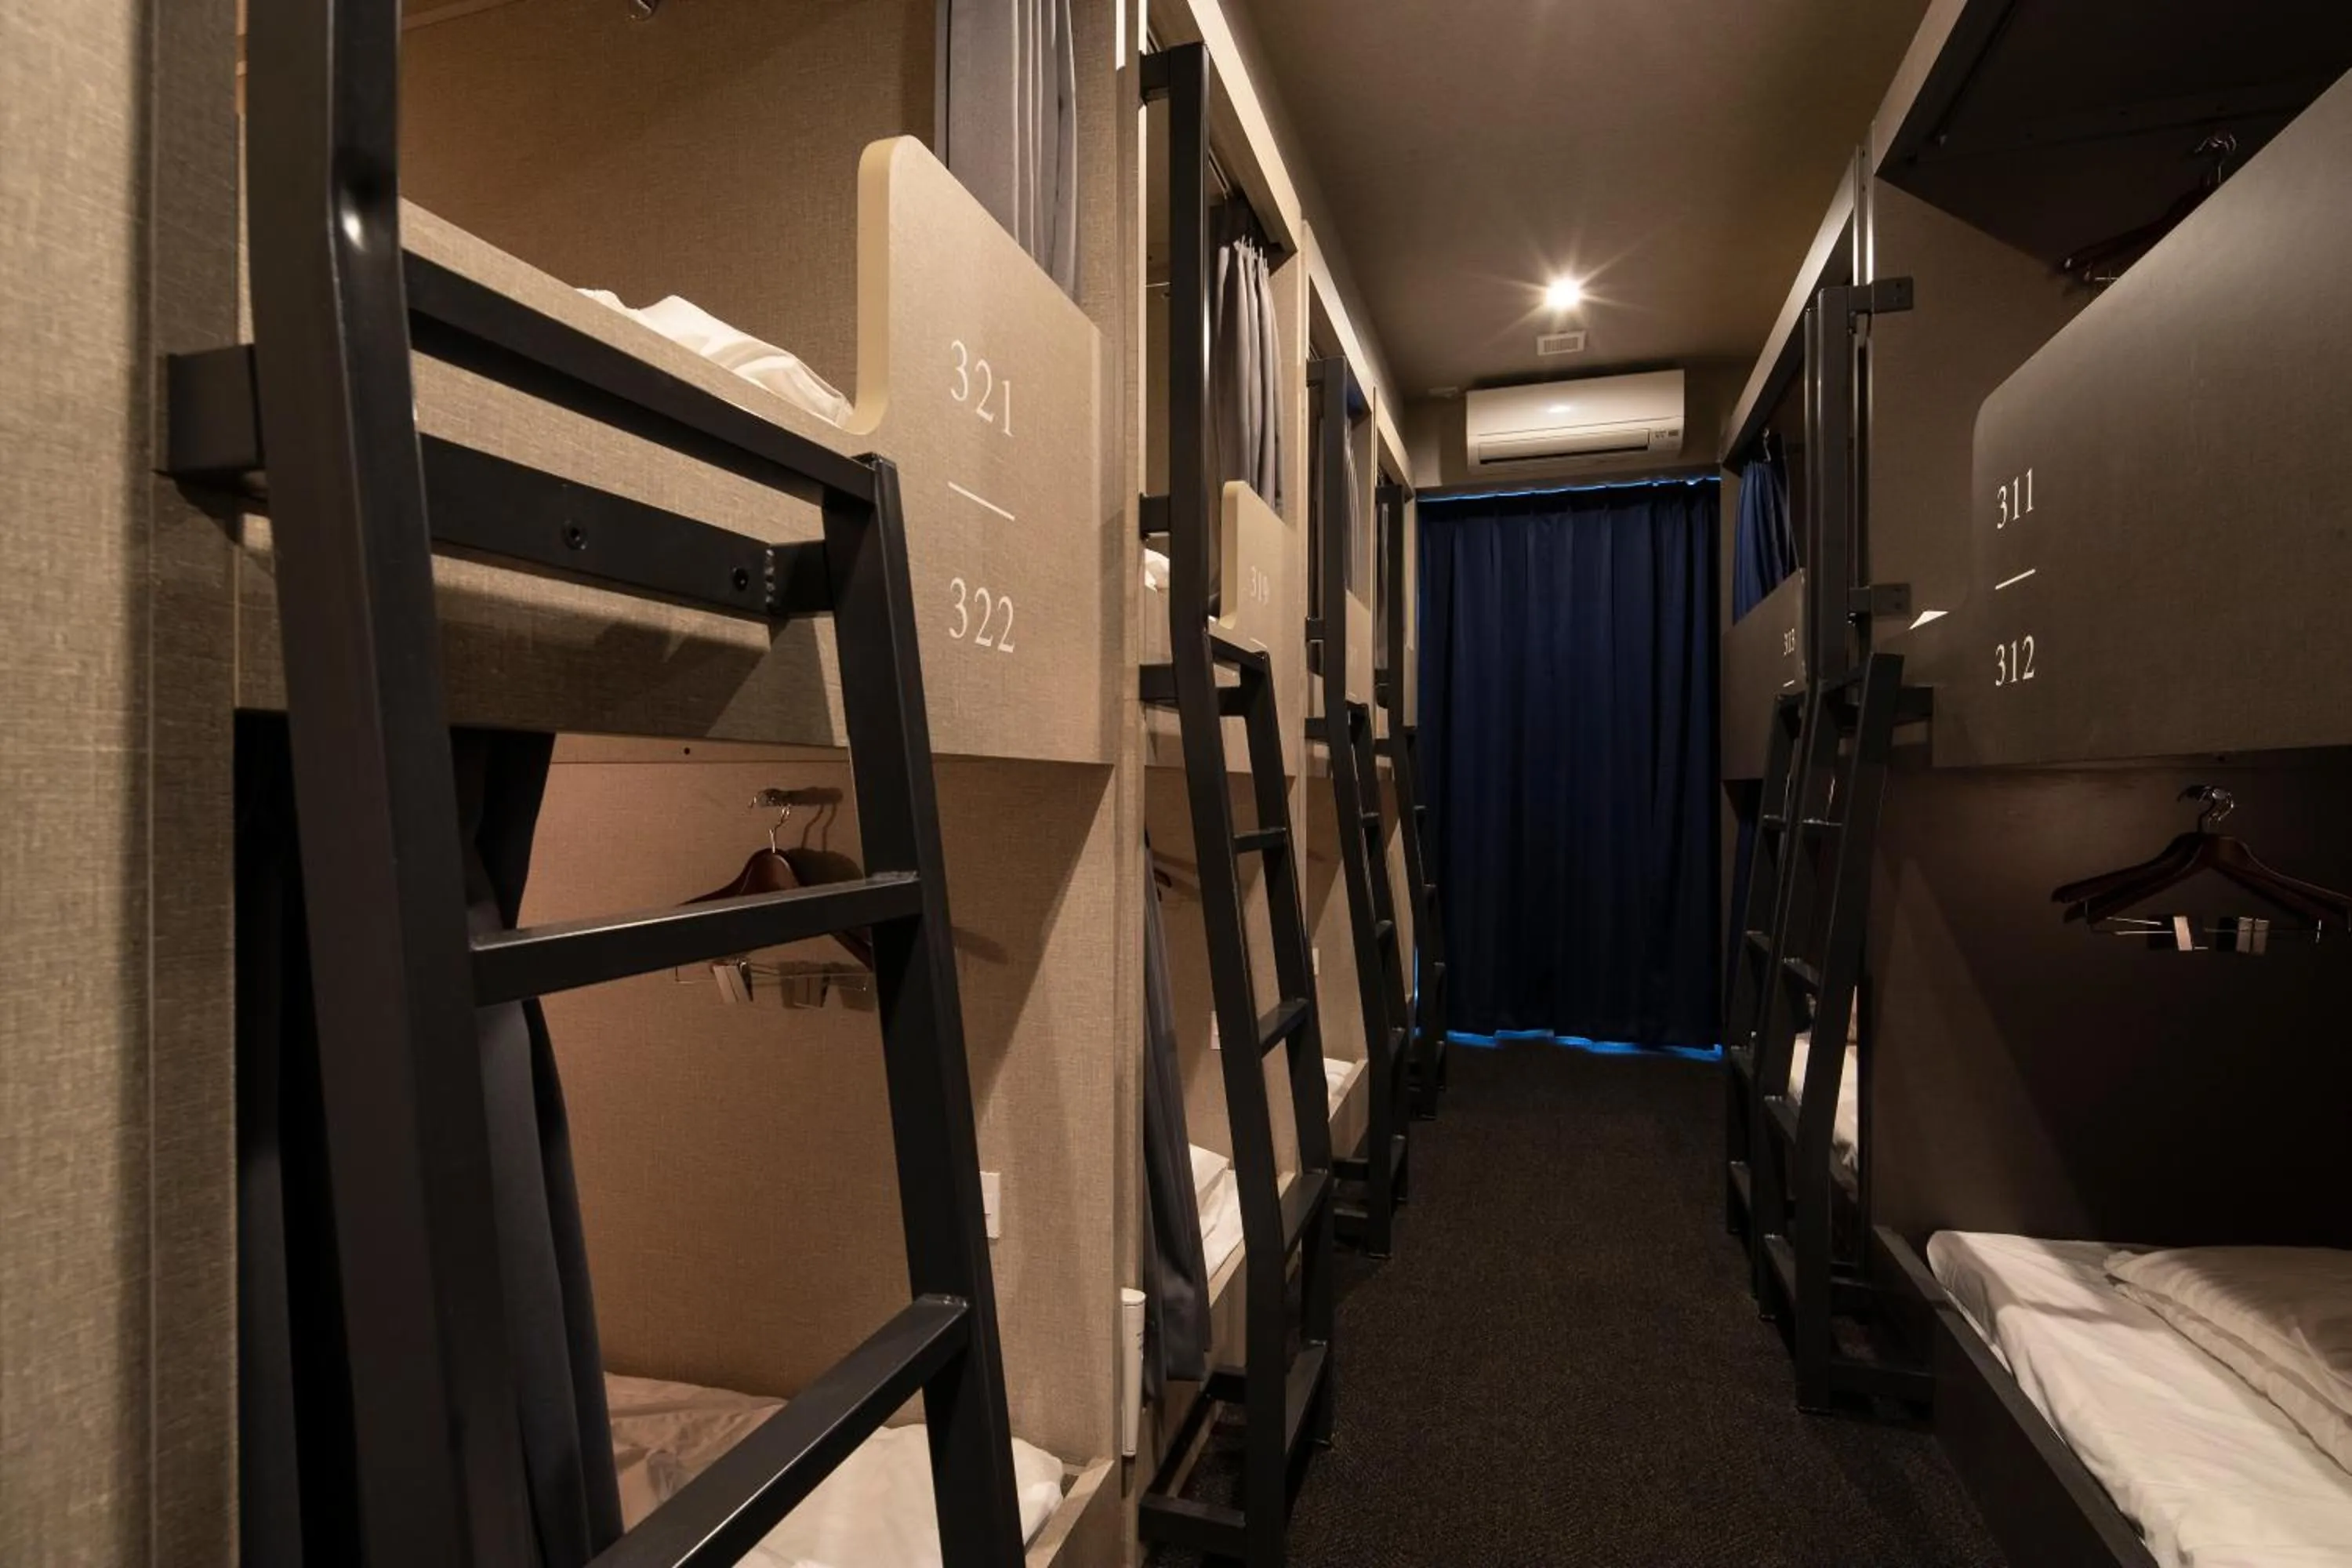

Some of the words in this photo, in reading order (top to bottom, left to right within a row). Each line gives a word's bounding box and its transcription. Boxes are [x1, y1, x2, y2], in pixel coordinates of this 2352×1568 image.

[949, 339, 1014, 437] 321
[1997, 468, 2034, 529] 311
[949, 577, 1015, 653] 322
[1995, 635, 2035, 686] 312
